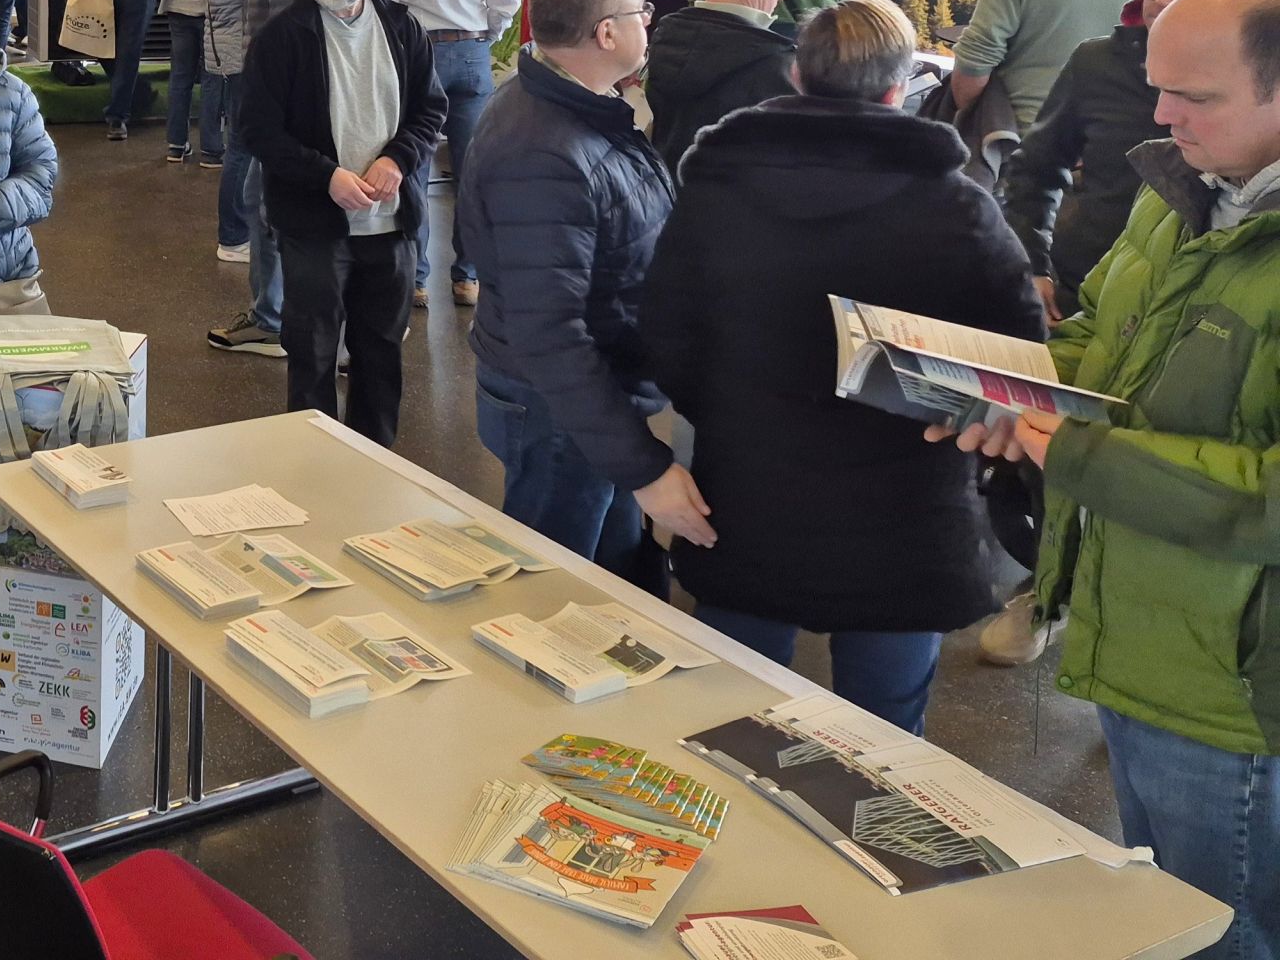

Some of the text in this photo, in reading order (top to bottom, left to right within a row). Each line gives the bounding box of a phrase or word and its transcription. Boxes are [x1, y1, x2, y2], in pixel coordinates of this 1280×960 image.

[71, 622, 88, 633] LEA
[39, 681, 70, 698] ZEKK
[903, 783, 972, 832] RATGEBER
